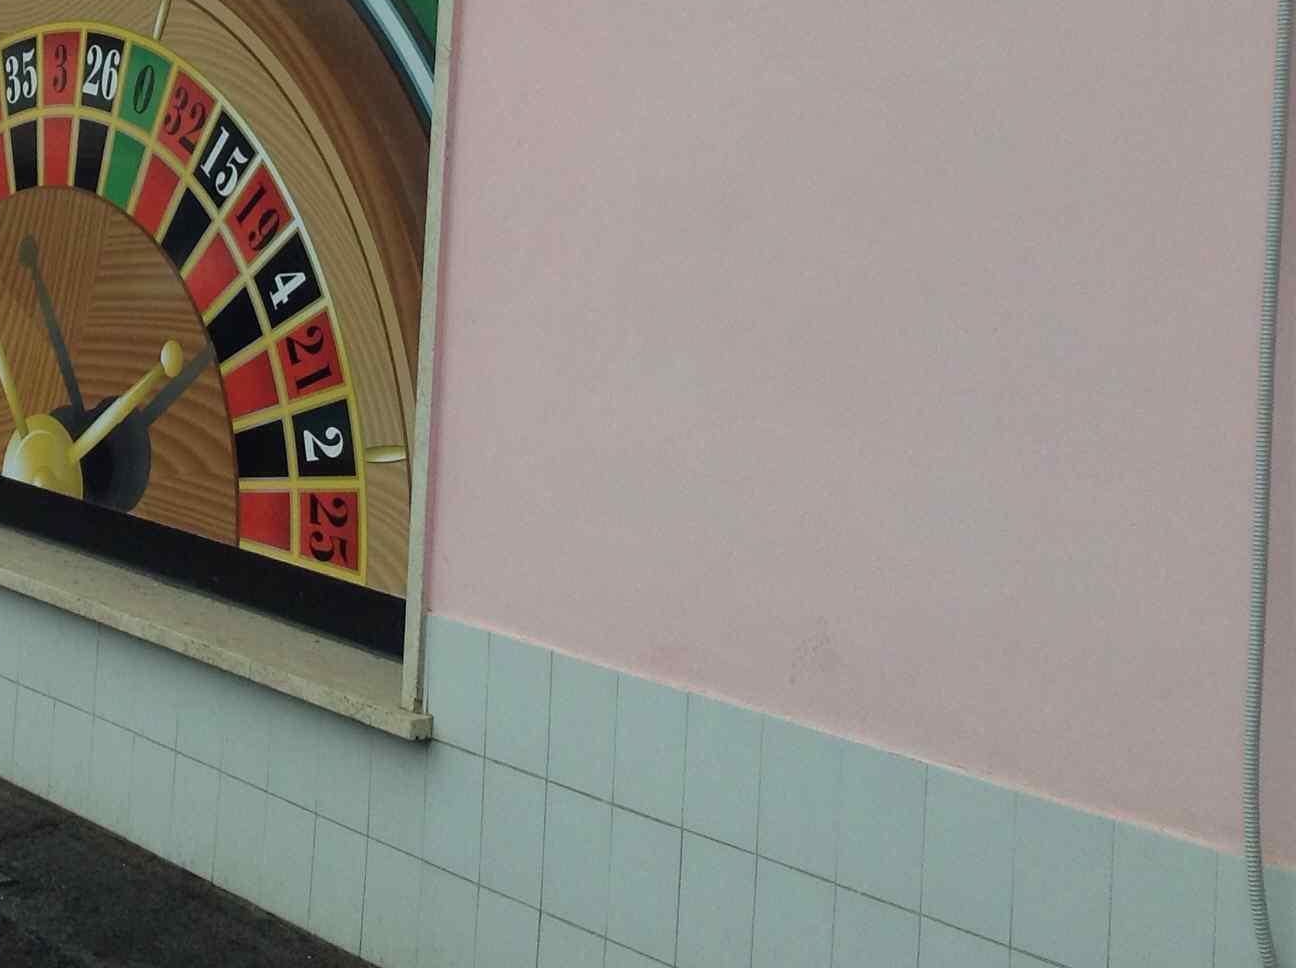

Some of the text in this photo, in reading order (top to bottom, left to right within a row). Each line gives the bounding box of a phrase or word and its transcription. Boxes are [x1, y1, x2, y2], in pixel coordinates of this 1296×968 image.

[5, 47, 38, 104] 35
[53, 44, 67, 93] 3
[82, 44, 120, 100] 26
[132, 64, 154, 114] 0
[164, 86, 205, 154] 32
[201, 126, 249, 197] 15
[236, 185, 280, 250] 19
[269, 272, 306, 311] 4
[285, 325, 332, 391] 21
[303, 426, 344, 462] 2
[308, 492, 349, 563] 25
